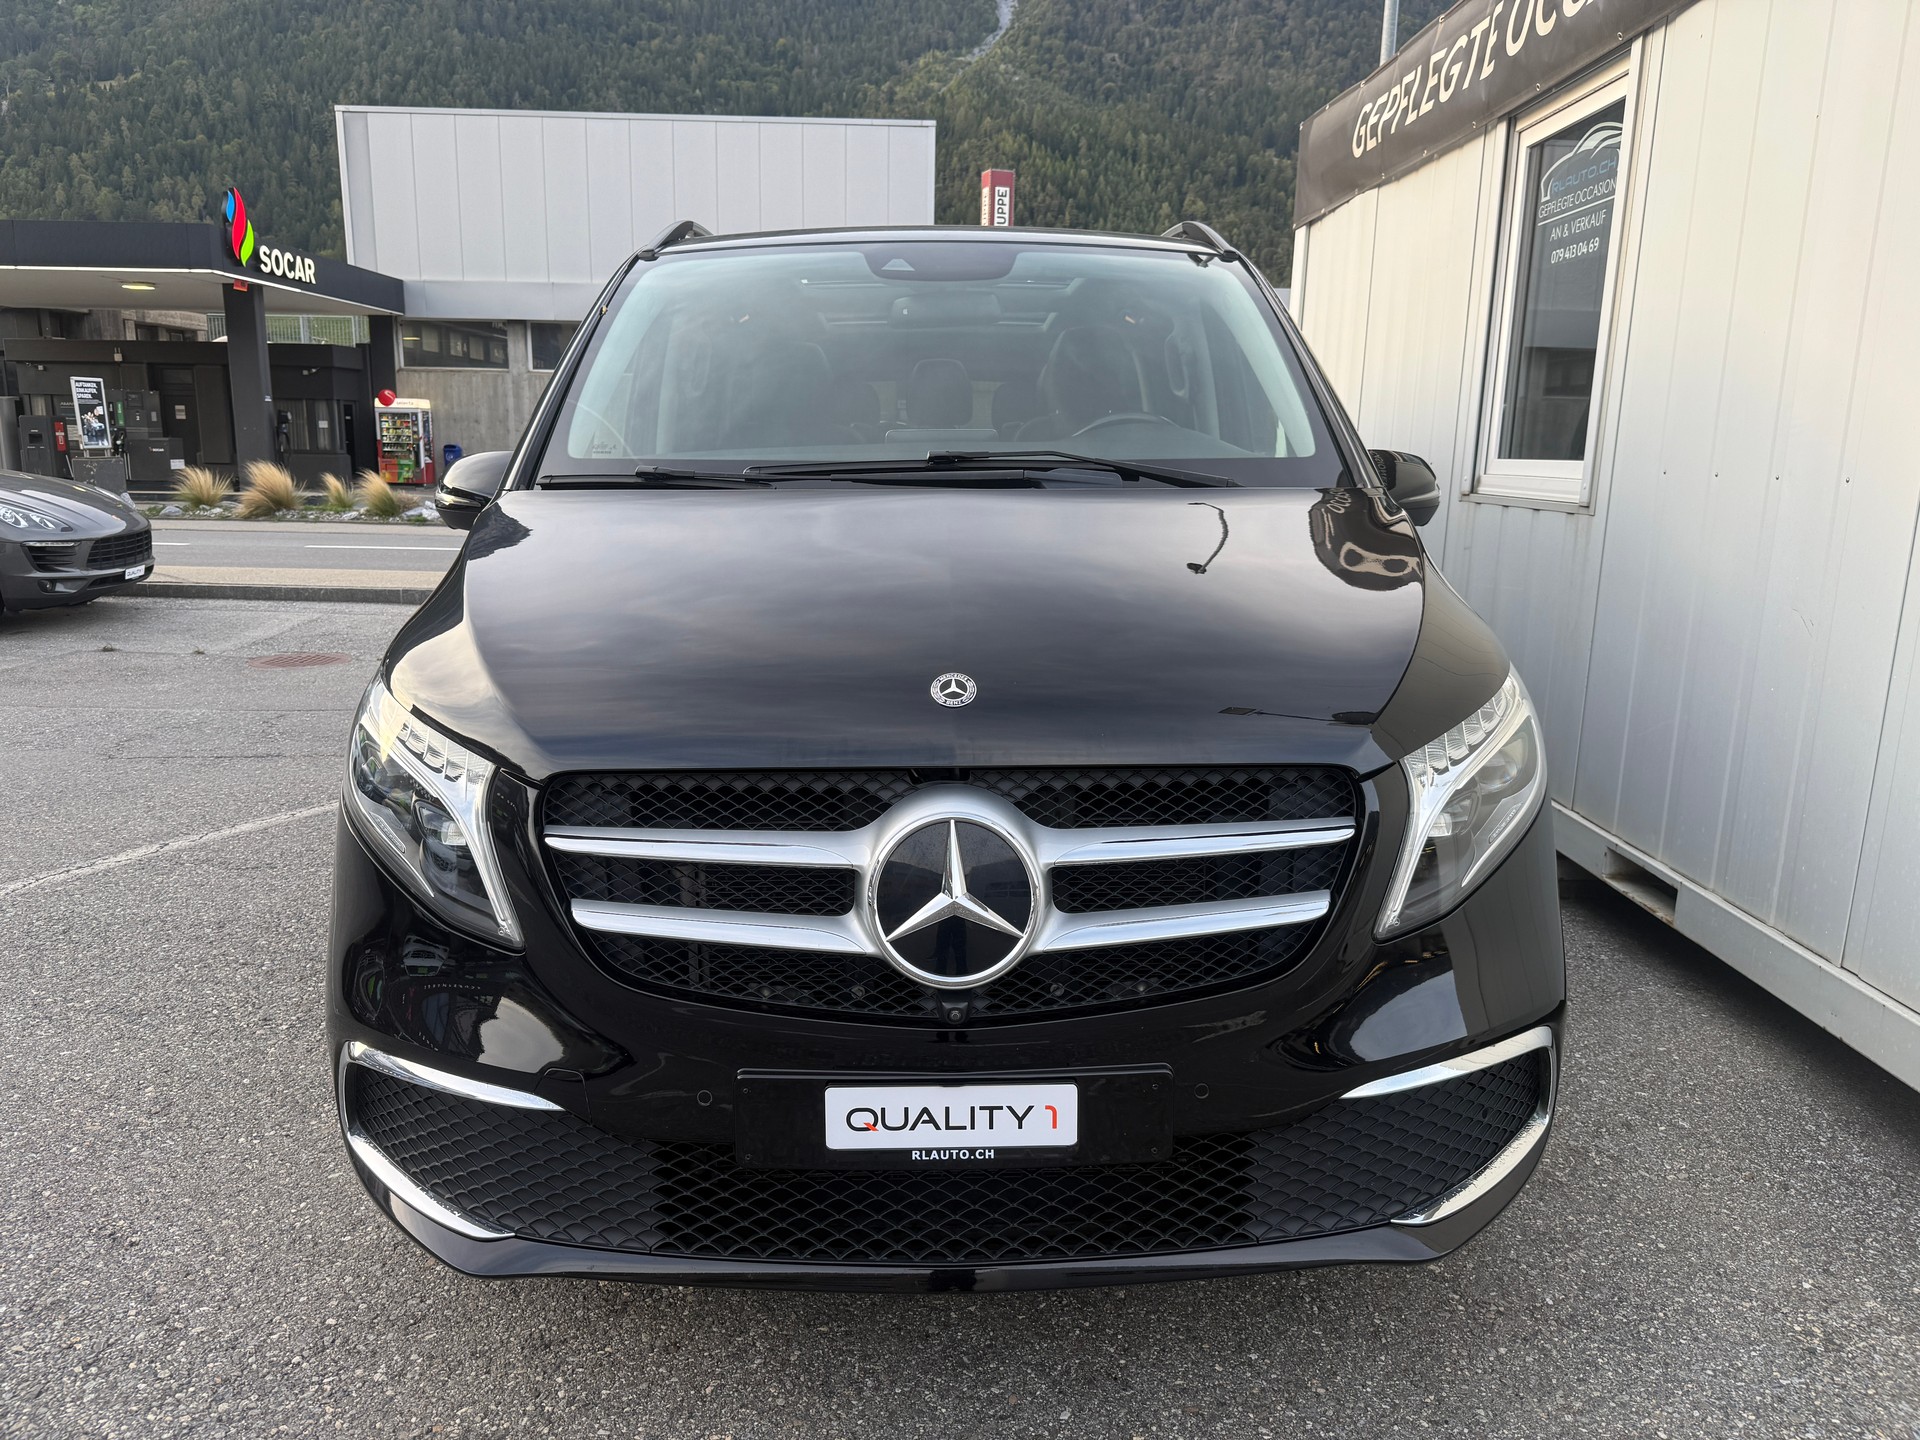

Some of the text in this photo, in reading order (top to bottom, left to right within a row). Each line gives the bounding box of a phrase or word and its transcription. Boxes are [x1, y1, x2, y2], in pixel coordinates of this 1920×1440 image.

[1352, 0, 1594, 158] GEPFLEGTE OC
[1551, 156, 1617, 193] RLAUTO.CH
[1538, 193, 1574, 218] GEPFLEGTE
[1550, 209, 1607, 242] AN & VERKAUF
[259, 244, 316, 285] SOCAR
[1551, 237, 1600, 264] 079 413 04 69
[846, 1105, 1058, 1132] QUALITY 1
[911, 1149, 995, 1161] RLAUTO.CH
